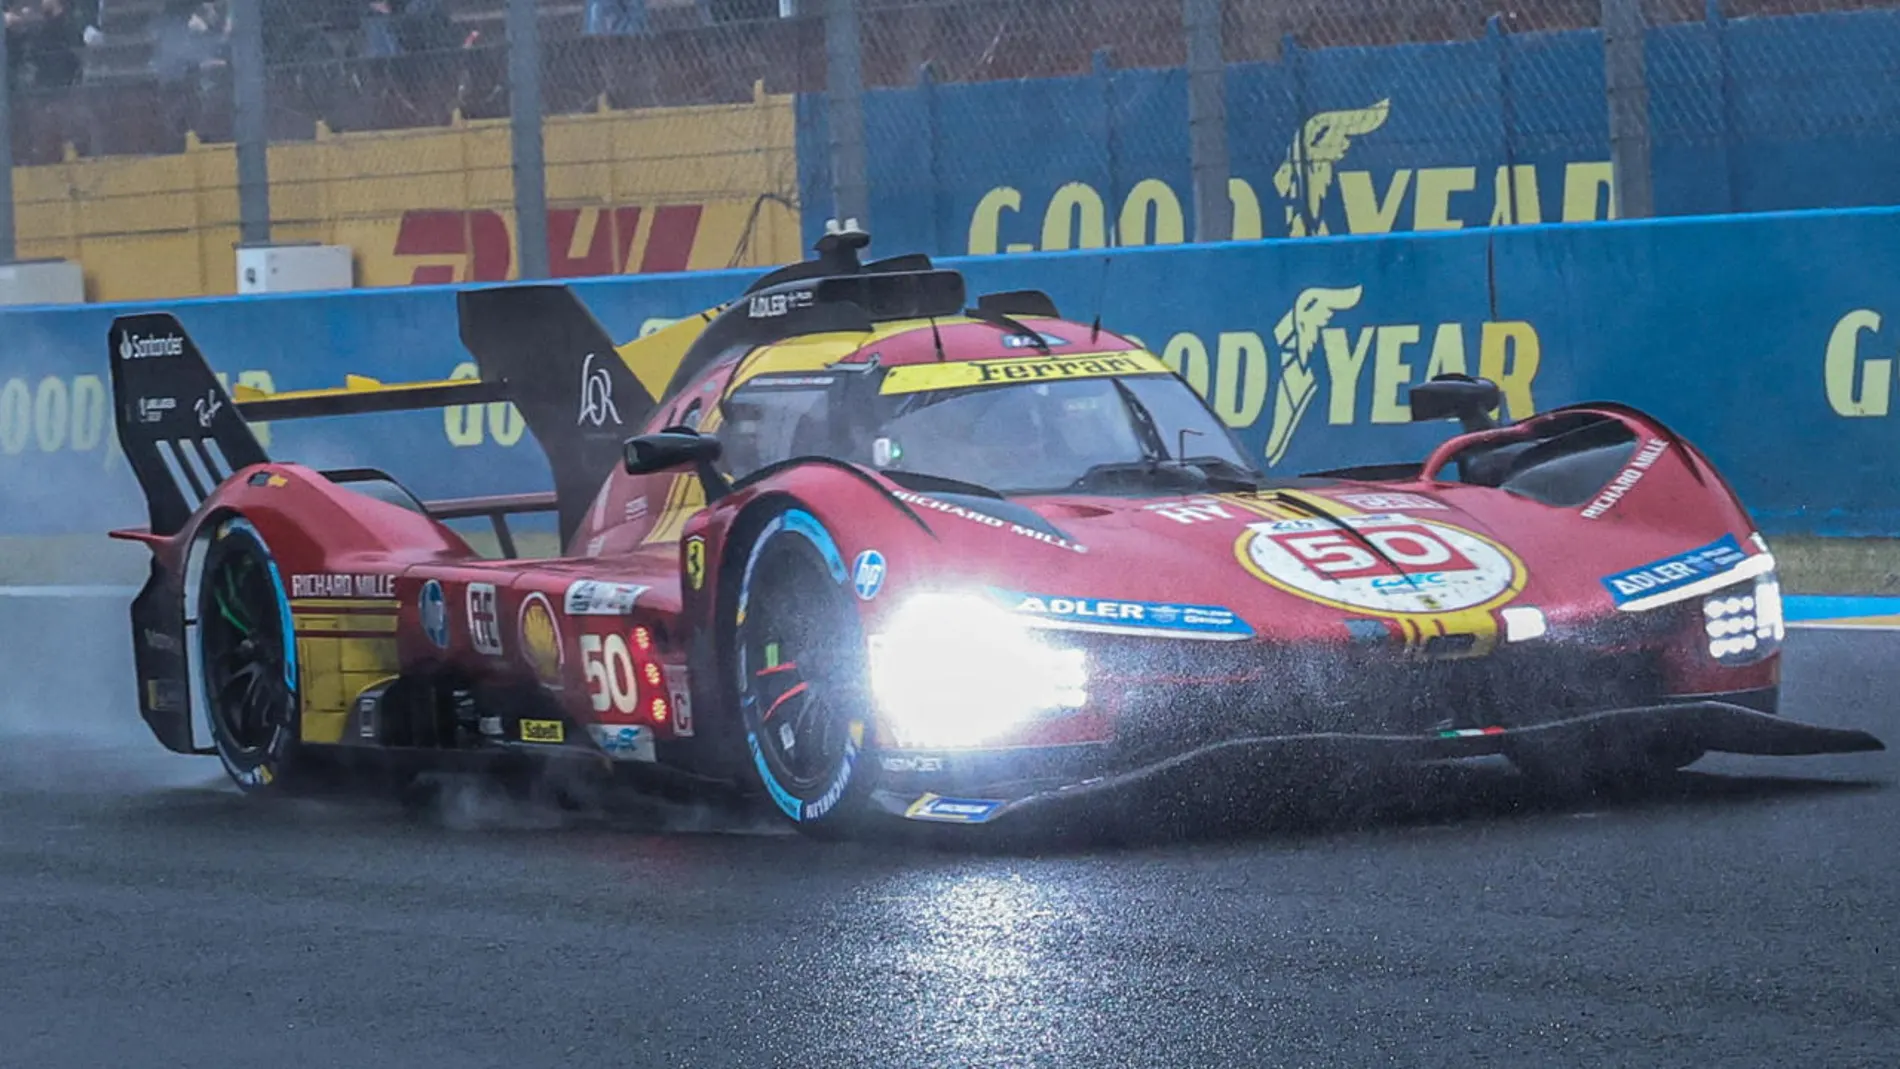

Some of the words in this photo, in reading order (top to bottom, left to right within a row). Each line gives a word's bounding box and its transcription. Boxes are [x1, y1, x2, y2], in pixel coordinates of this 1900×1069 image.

[132, 333, 184, 358] Santander
[969, 352, 1147, 383] Ferrari
[1580, 468, 1644, 519] RICHARD
[1635, 437, 1670, 470] MILLE
[893, 490, 1004, 528] RICHARD
[1011, 523, 1089, 554] MILLE
[1284, 531, 1452, 573] 50
[292, 574, 352, 597] RICHARD
[355, 574, 396, 597] MILLE
[1611, 562, 1699, 596] ADLER
[1016, 597, 1144, 619] ADLER
[580, 633, 638, 714] 50
